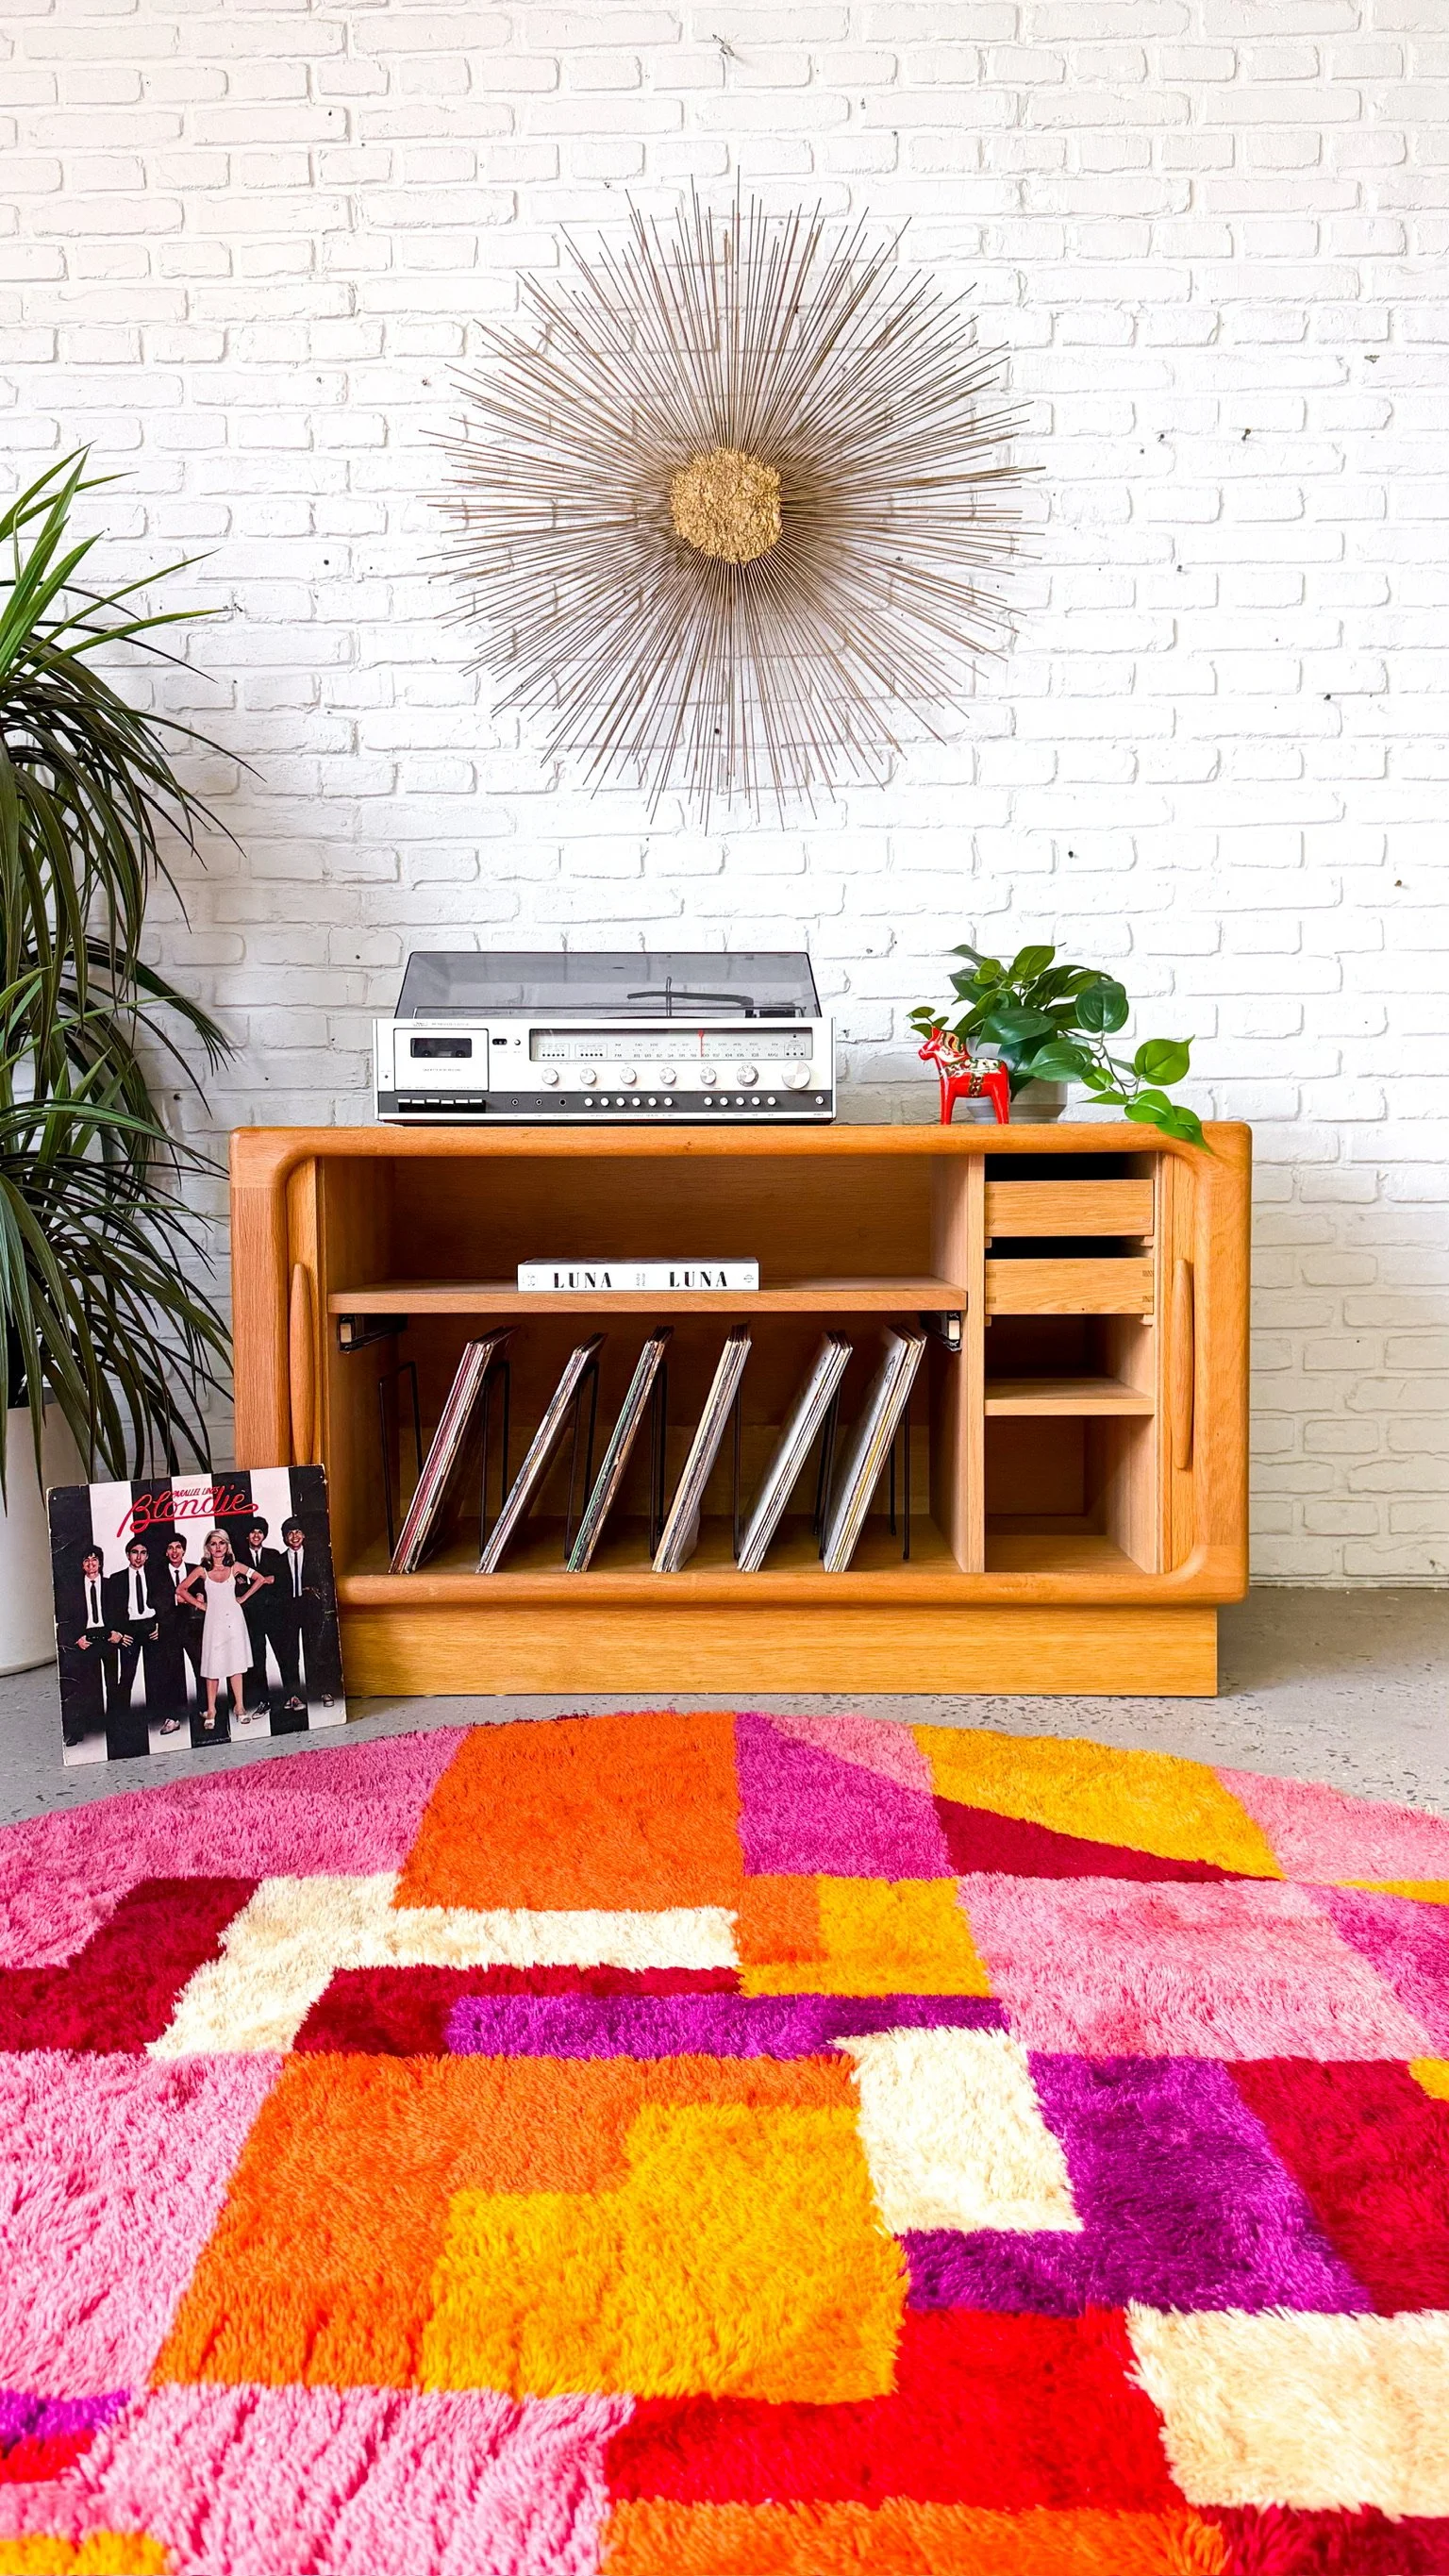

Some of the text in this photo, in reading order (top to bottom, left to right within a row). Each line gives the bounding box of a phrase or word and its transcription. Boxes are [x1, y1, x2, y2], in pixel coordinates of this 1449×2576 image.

[554, 1272, 612, 1289] LUNA
[669, 1271, 727, 1288] LUNA
[173, 1486, 220, 1497] PARALLEL LINES
[116, 1484, 258, 1538] Blondie
